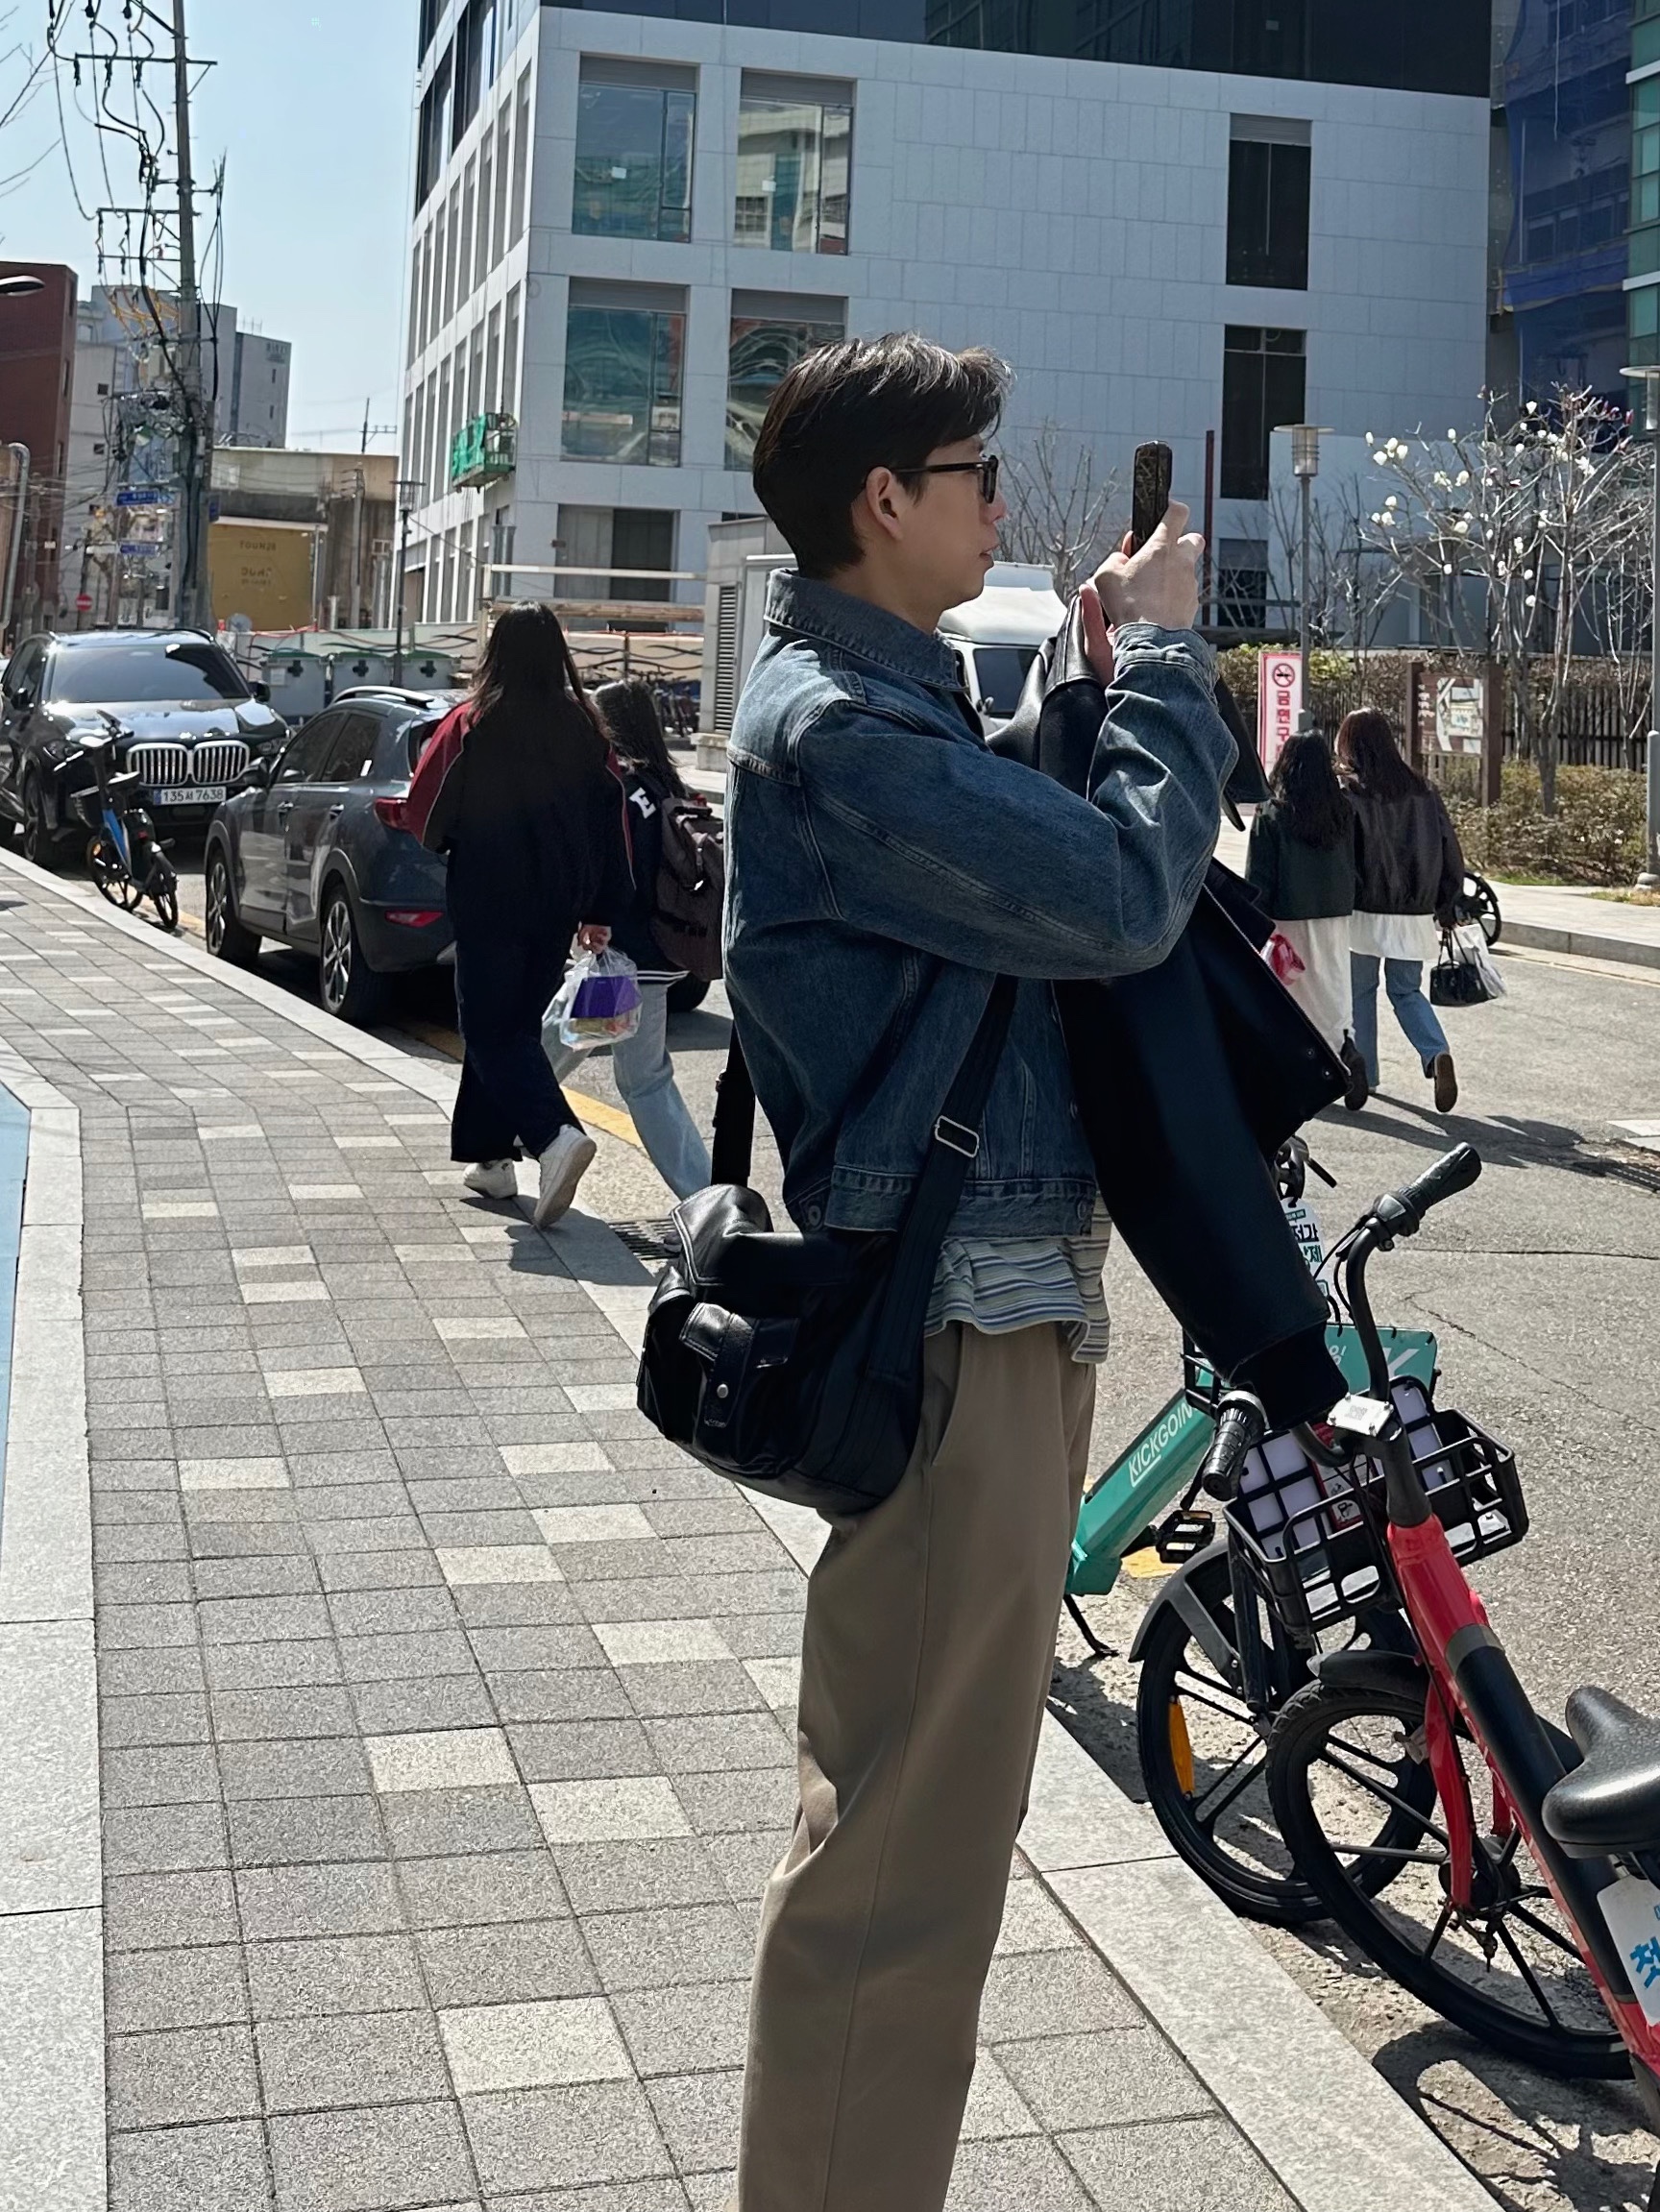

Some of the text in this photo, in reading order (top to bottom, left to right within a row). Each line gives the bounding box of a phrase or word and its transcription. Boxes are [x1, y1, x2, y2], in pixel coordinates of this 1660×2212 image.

[1277, 691, 1290, 757] 금연구
[196, 789, 224, 800] 7638
[629, 787, 657, 819] E
